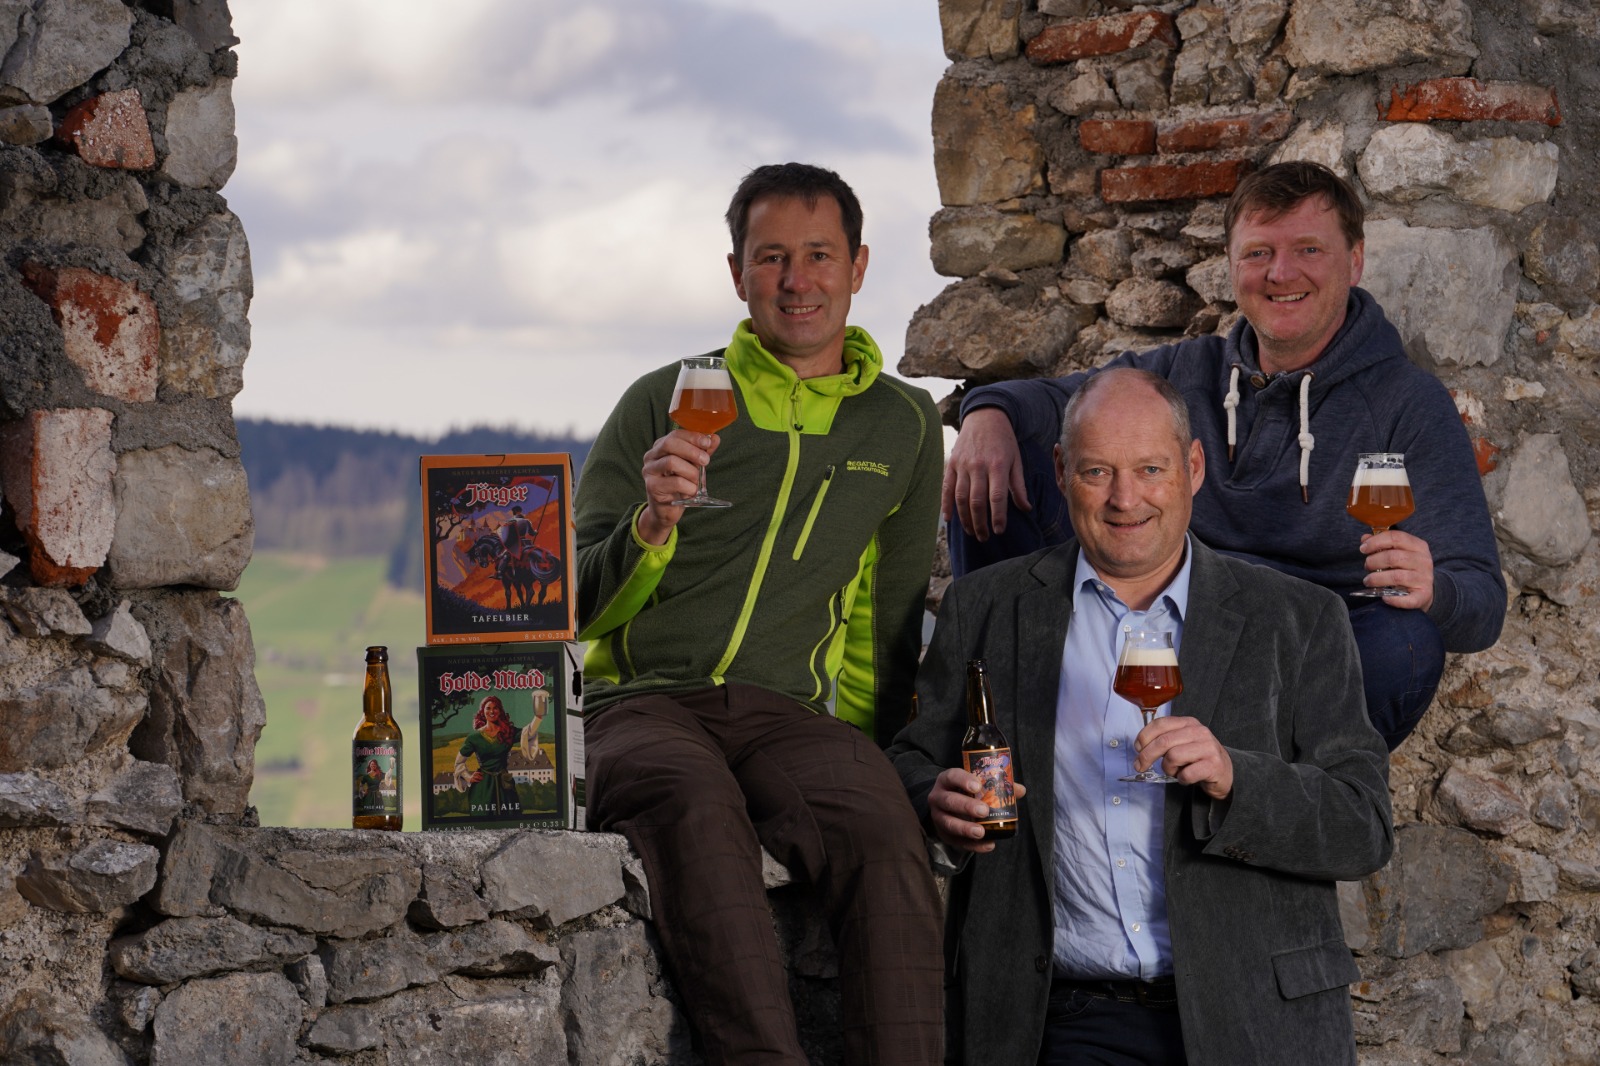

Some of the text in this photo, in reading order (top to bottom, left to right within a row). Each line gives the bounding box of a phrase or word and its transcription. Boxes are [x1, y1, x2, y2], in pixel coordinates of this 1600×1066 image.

[846, 460, 877, 468] REGATTA
[466, 482, 528, 507] Jörger
[472, 614, 530, 623] TAFELBIER
[439, 668, 545, 696] Holde Maid
[471, 802, 521, 812] PALE ALE
